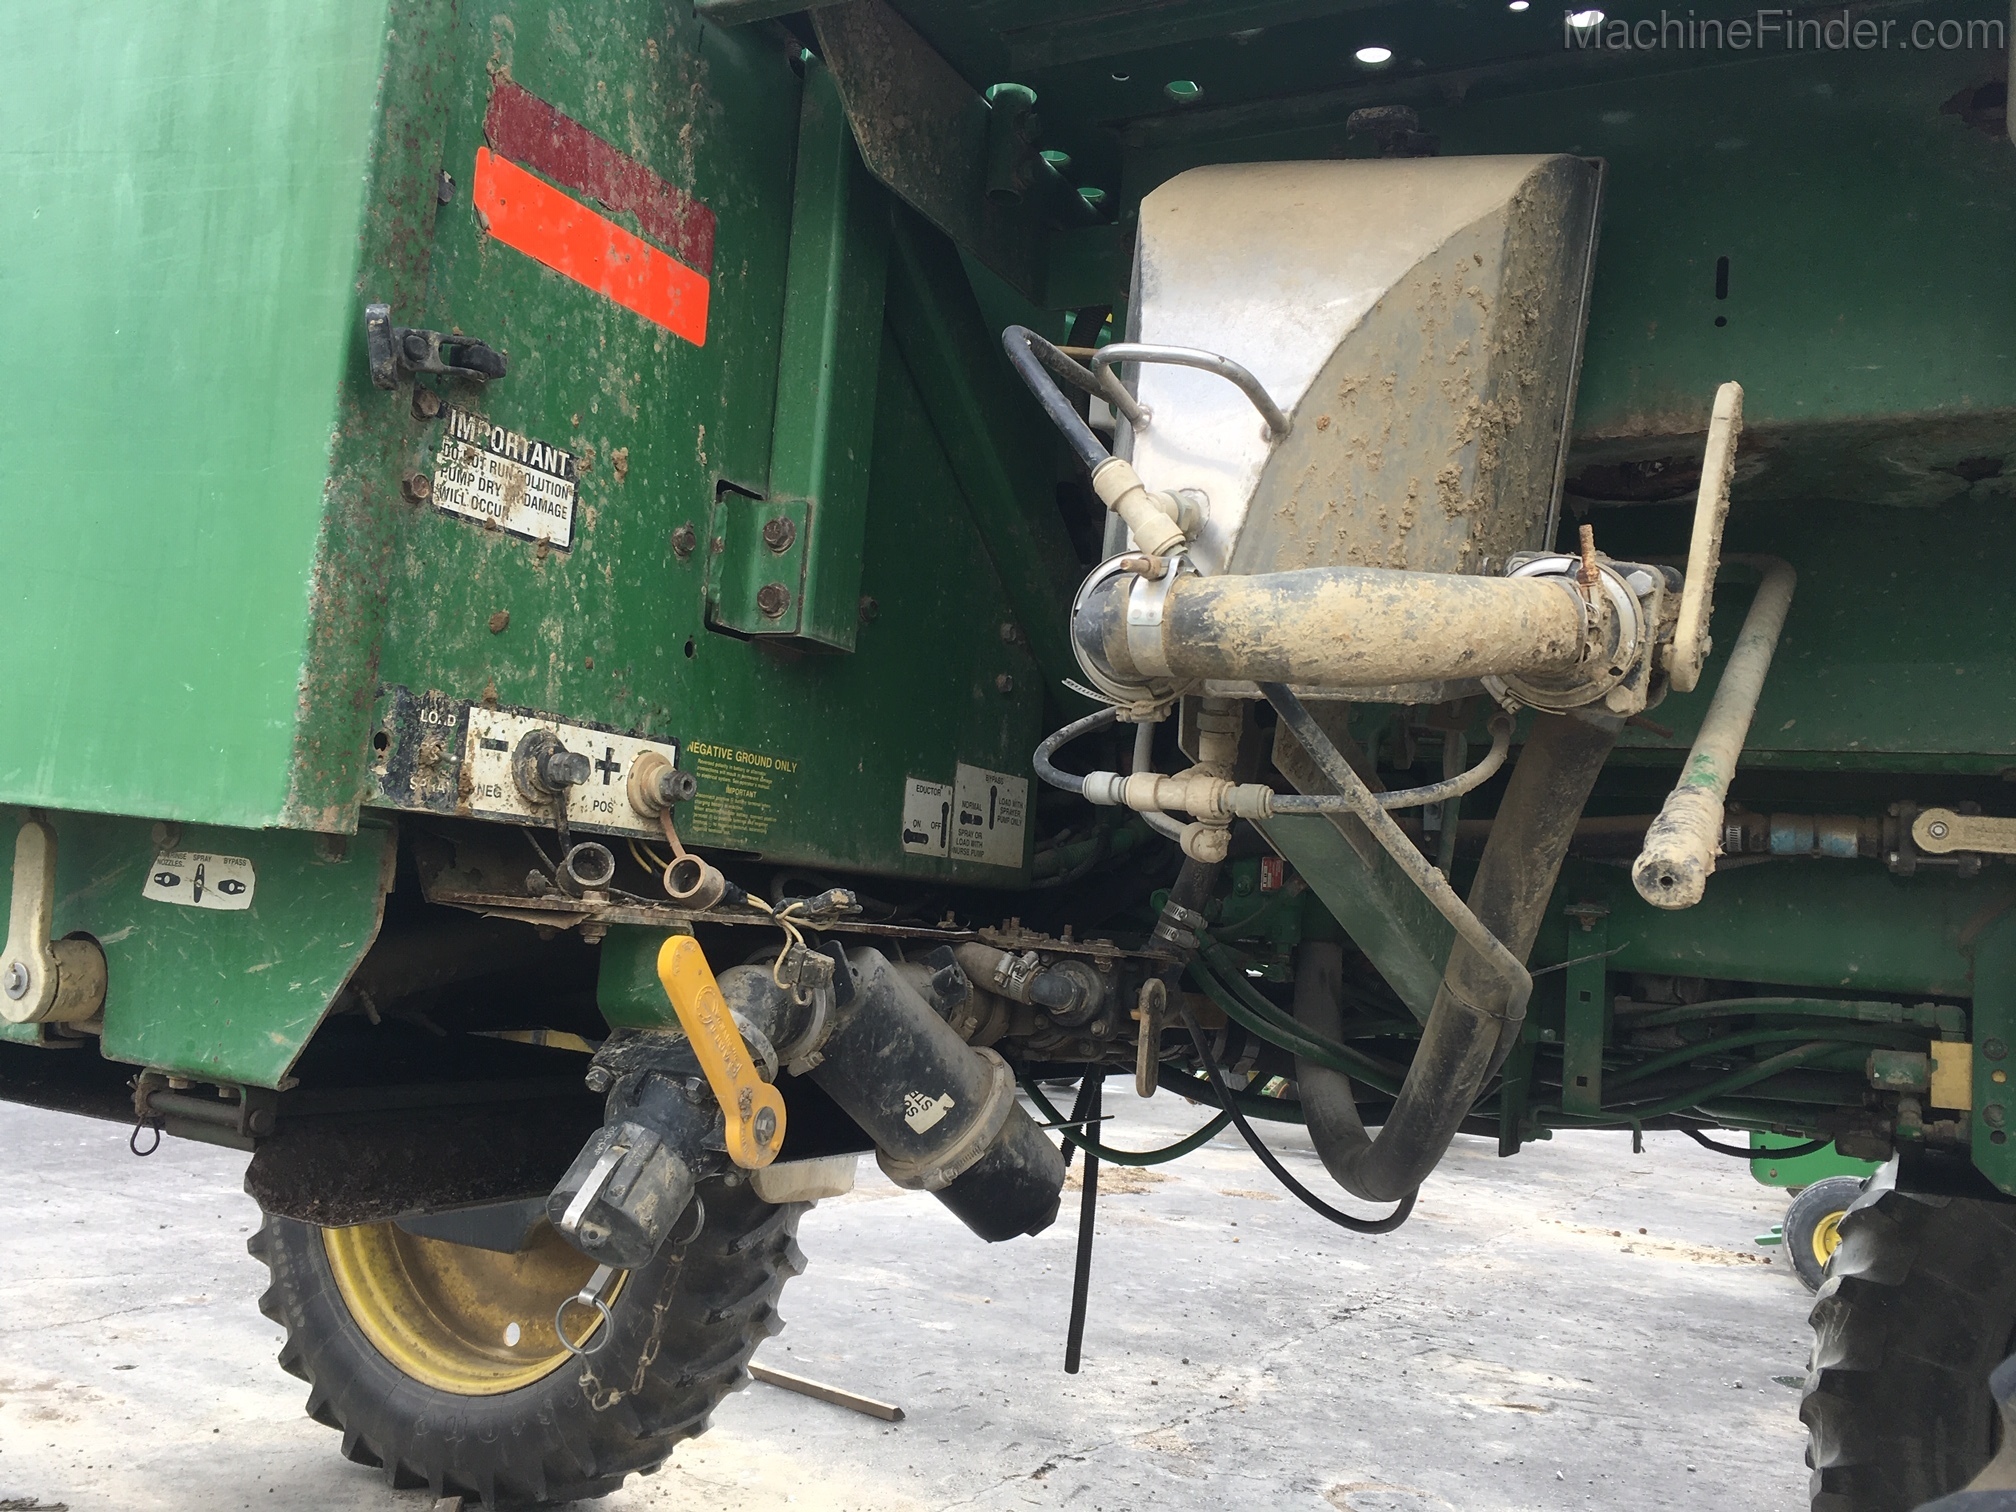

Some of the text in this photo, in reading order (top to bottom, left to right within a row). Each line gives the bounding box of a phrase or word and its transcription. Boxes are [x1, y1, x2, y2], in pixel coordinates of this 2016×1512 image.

[443, 443, 568, 501] DO OT RUN OLUTION
[440, 468, 568, 520] PUMP DRY DAMAGE
[440, 485, 513, 522] WILL OCCU.
[687, 741, 733, 760] NEGATIVE
[735, 751, 772, 769] GROUND
[774, 759, 798, 773] ONLY
[477, 784, 501, 798] NEG
[725, 786, 757, 798] IMPORTANT
[916, 785, 942, 796] EDUCTOR
[593, 800, 614, 813] POS
[961, 800, 982, 811] NORMAL
[912, 820, 921, 828] ON
[930, 821, 942, 830] OFF
[958, 829, 983, 839] SPRAY OR
[956, 838, 983, 848] LOAD WITH
[193, 854, 212, 862] SPRAY
[223, 857, 247, 866] BYPASS
